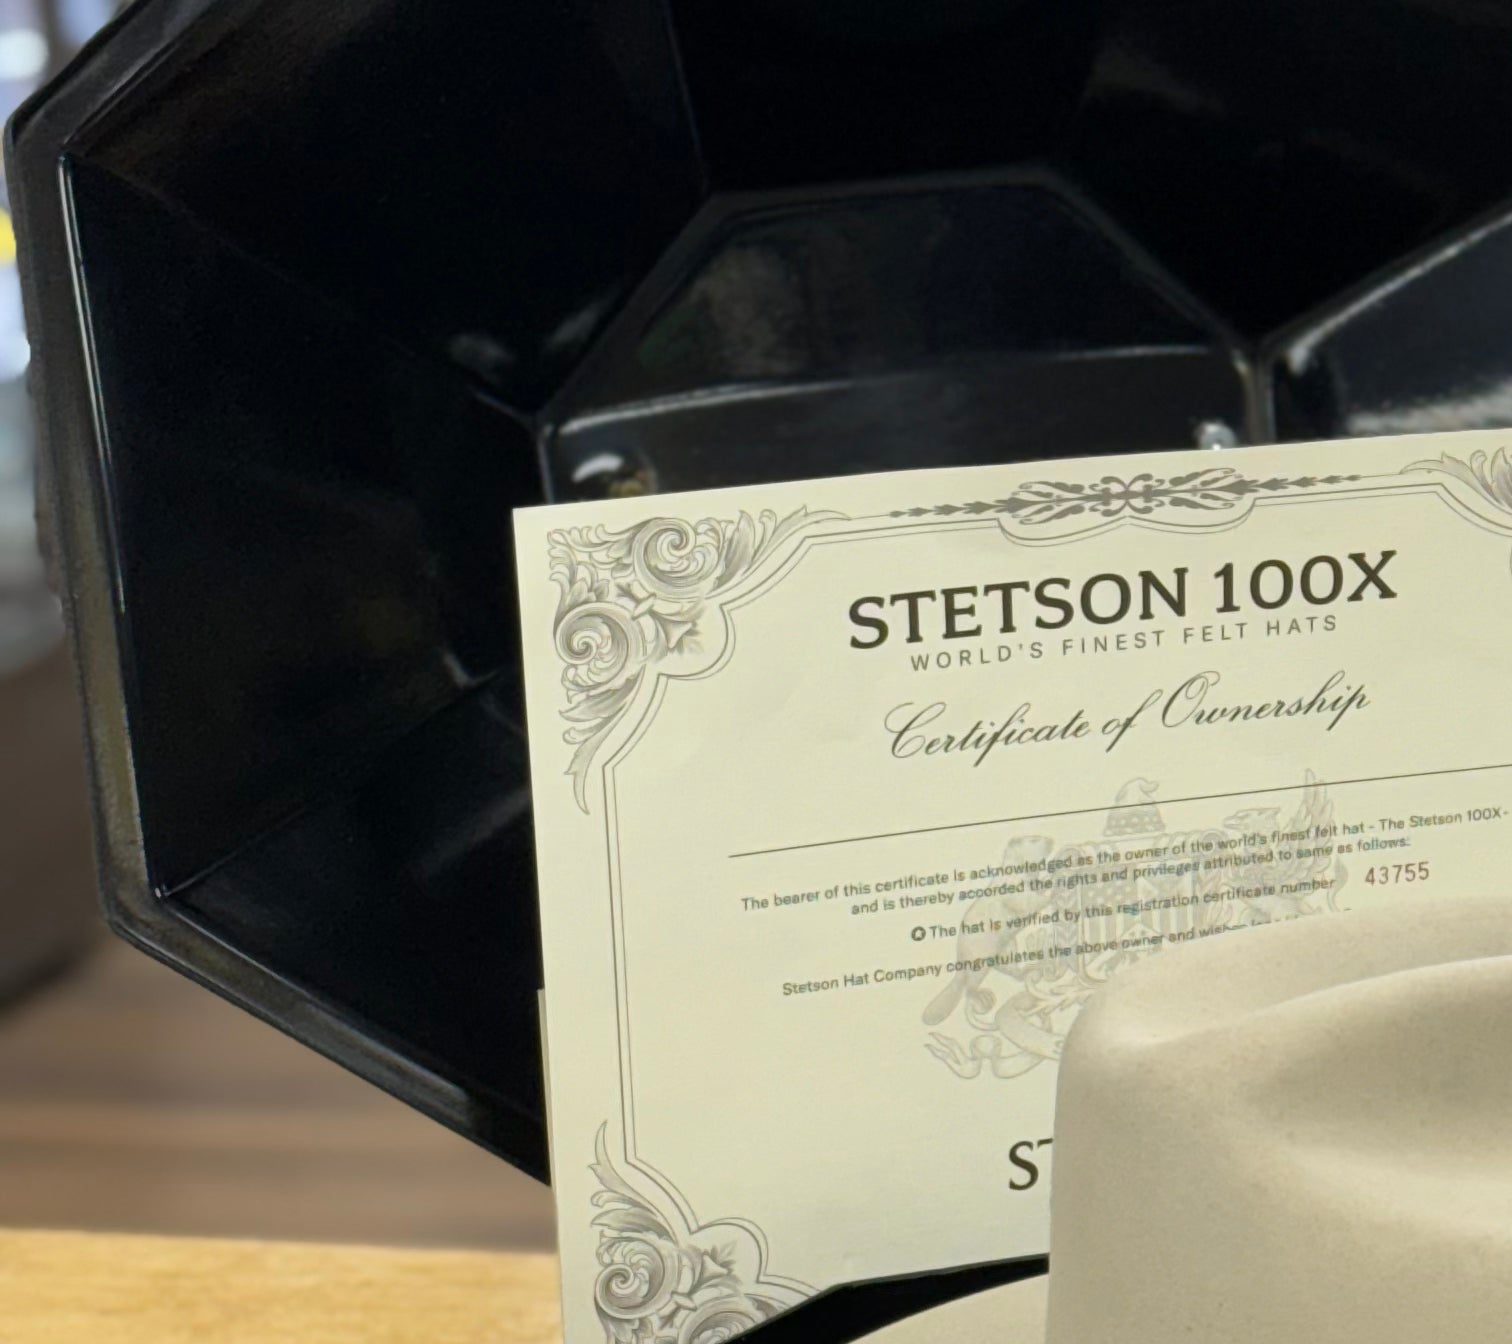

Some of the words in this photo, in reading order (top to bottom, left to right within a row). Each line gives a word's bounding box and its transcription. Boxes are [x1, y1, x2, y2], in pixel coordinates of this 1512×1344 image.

[849, 567, 1188, 649] STETSON
[1214, 550, 1397, 613] 100X
[911, 642, 1043, 671] WORLD'S
[1062, 630, 1165, 656] FINEST
[1183, 622, 1248, 645] FELT
[1266, 615, 1337, 637] HATS
[884, 702, 1091, 767] Certificate
[1101, 689, 1164, 752] of
[1161, 670, 1370, 731] Ownership
[741, 896, 769, 912] The
[774, 890, 820, 907] bearer
[825, 884, 841, 899] of
[843, 882, 871, 897] this
[875, 871, 949, 893] certificate
[953, 868, 966, 882] is
[970, 856, 1072, 880] acknowledged
[1077, 854, 1093, 866] as
[1098, 849, 1121, 864] the
[1125, 846, 1169, 860] owner
[1172, 841, 1187, 855] of
[1191, 838, 1214, 853] the
[1218, 831, 1267, 848] world's
[1271, 827, 1311, 843] finest
[1315, 823, 1338, 838] felt
[1343, 820, 1365, 836] hat
[1379, 817, 1405, 832] The
[1409, 809, 1463, 828] Stetson
[851, 900, 878, 915] and
[883, 897, 895, 911] is
[899, 891, 955, 908] thereby
[958, 880, 1025, 901] accorded
[1029, 876, 1053, 892] the
[1056, 872, 1097, 890] rights
[1101, 868, 1128, 883] and
[1133, 861, 1200, 881] privileges
[1203, 851, 1273, 871] attributed
[1278, 849, 1292, 861] to
[1296, 845, 1334, 859] same
[1337, 842, 1353, 854] as
[929, 923, 957, 939] The
[961, 919, 985, 935] hat
[989, 918, 1001, 931] is
[1006, 909, 1059, 929] verified
[1064, 908, 1081, 923] by
[1085, 903, 1113, 919] this
[1117, 892, 1199, 915] registration
[1203, 885, 1276, 904] certificate
[1280, 877, 1336, 894] number
[1364, 860, 1431, 887] 43755
[782, 976, 839, 996] Stetson
[843, 972, 870, 988] Hat
[873, 961, 943, 984] Company
[946, 947, 1044, 973] congratulates
[1048, 943, 1072, 958] the
[1075, 938, 1118, 955] above
[1121, 934, 1165, 950] owner
[1168, 926, 1196, 943] and
